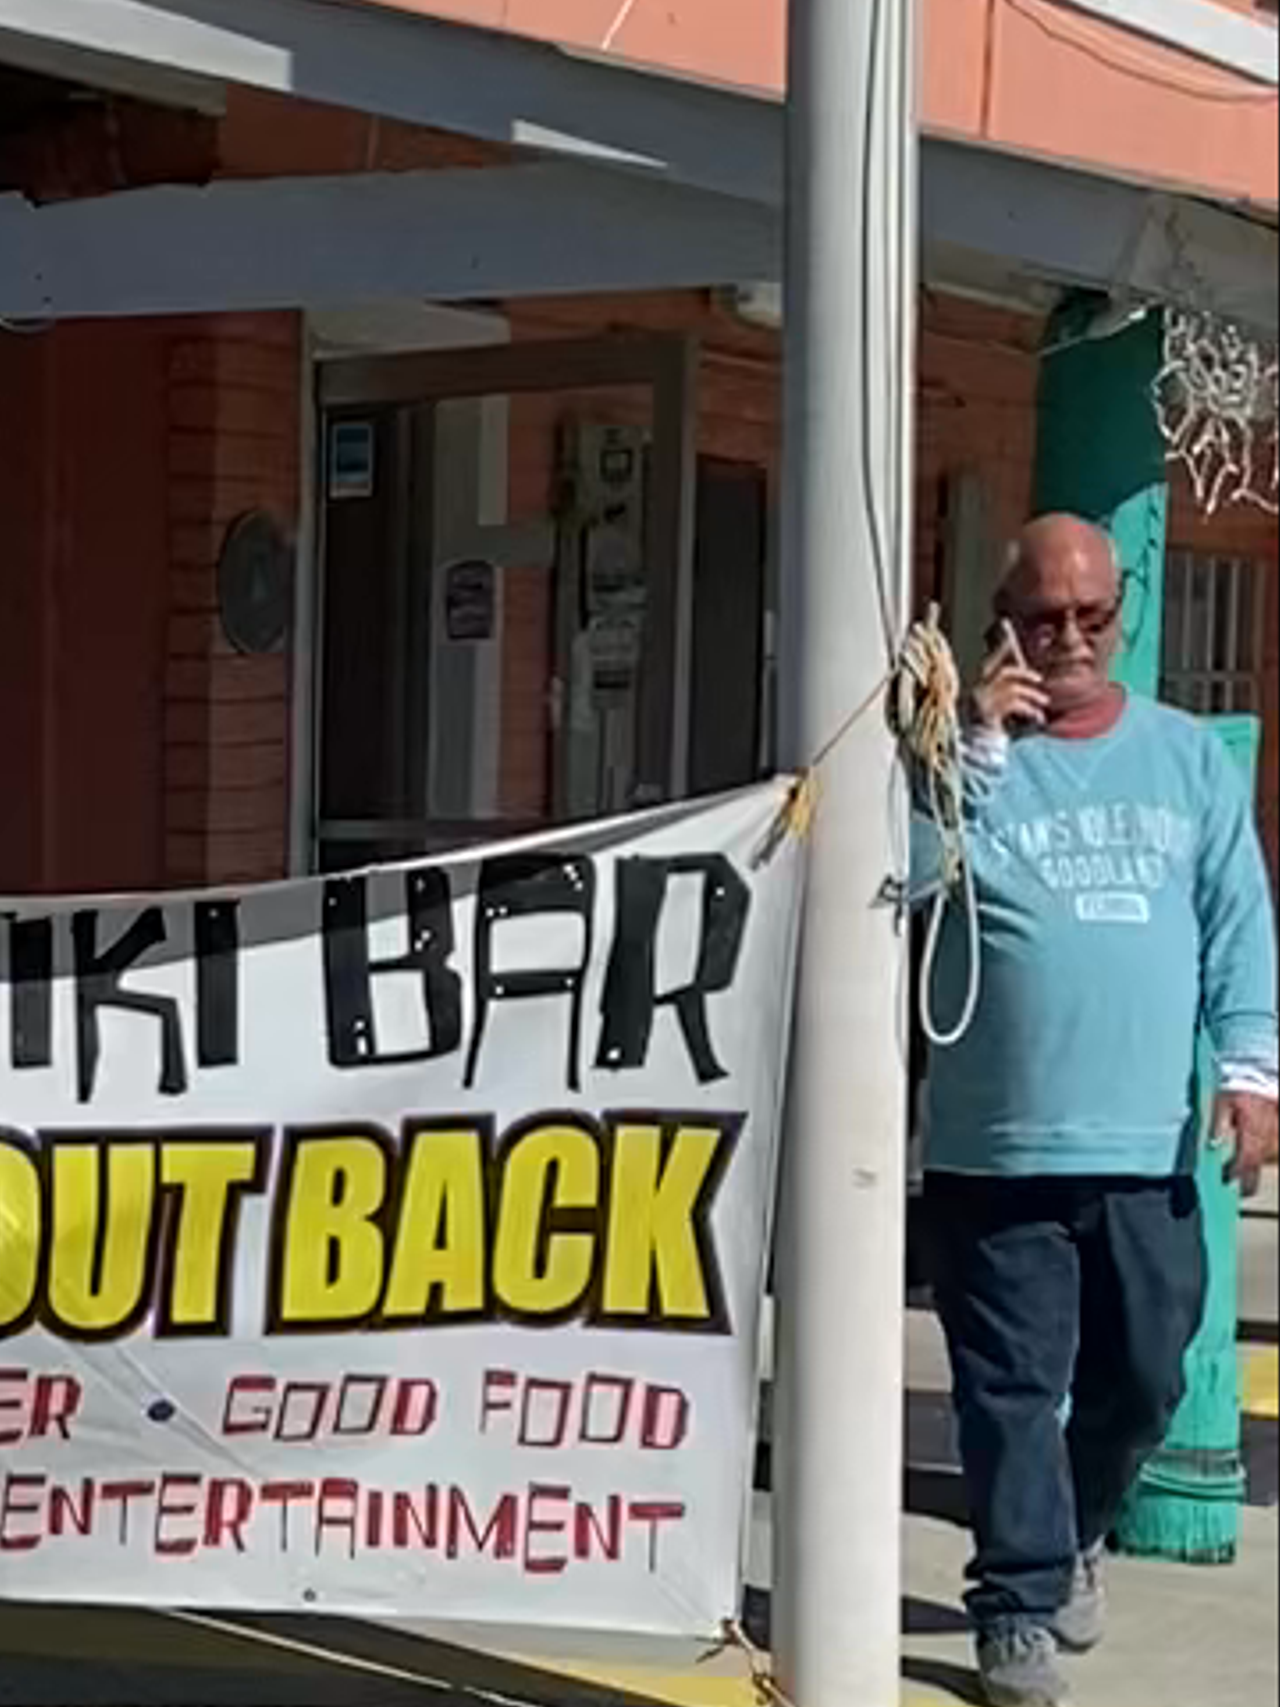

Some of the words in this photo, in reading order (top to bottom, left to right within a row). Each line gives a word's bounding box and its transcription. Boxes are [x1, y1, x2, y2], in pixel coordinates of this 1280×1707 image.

[322, 849, 753, 1091] BAR
[264, 1110, 749, 1339] BACK
[221, 1371, 439, 1442] GOOD
[478, 1369, 691, 1451] FOOD
